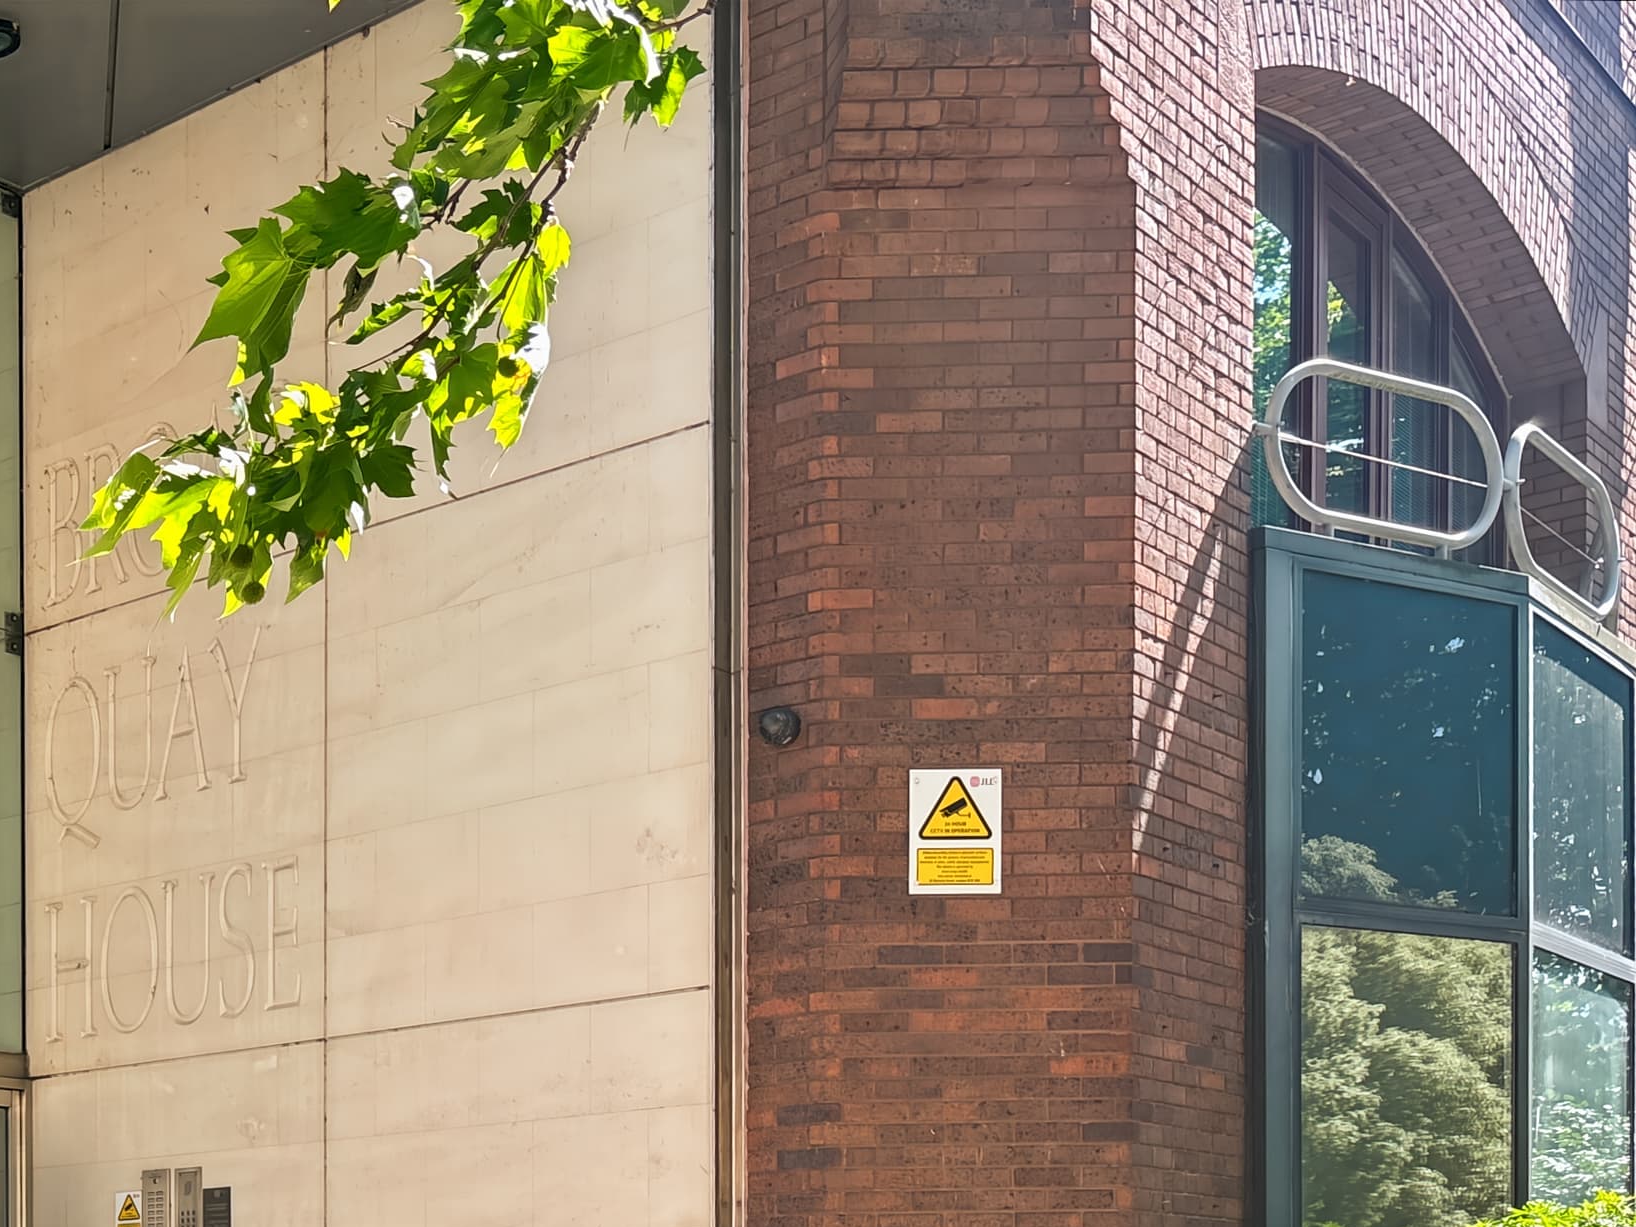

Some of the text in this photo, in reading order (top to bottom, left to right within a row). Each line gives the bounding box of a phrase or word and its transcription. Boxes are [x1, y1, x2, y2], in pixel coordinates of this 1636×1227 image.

[41, 398, 254, 610] BRO
[44, 624, 270, 849] QUAY
[44, 855, 302, 1043] HOUSE
